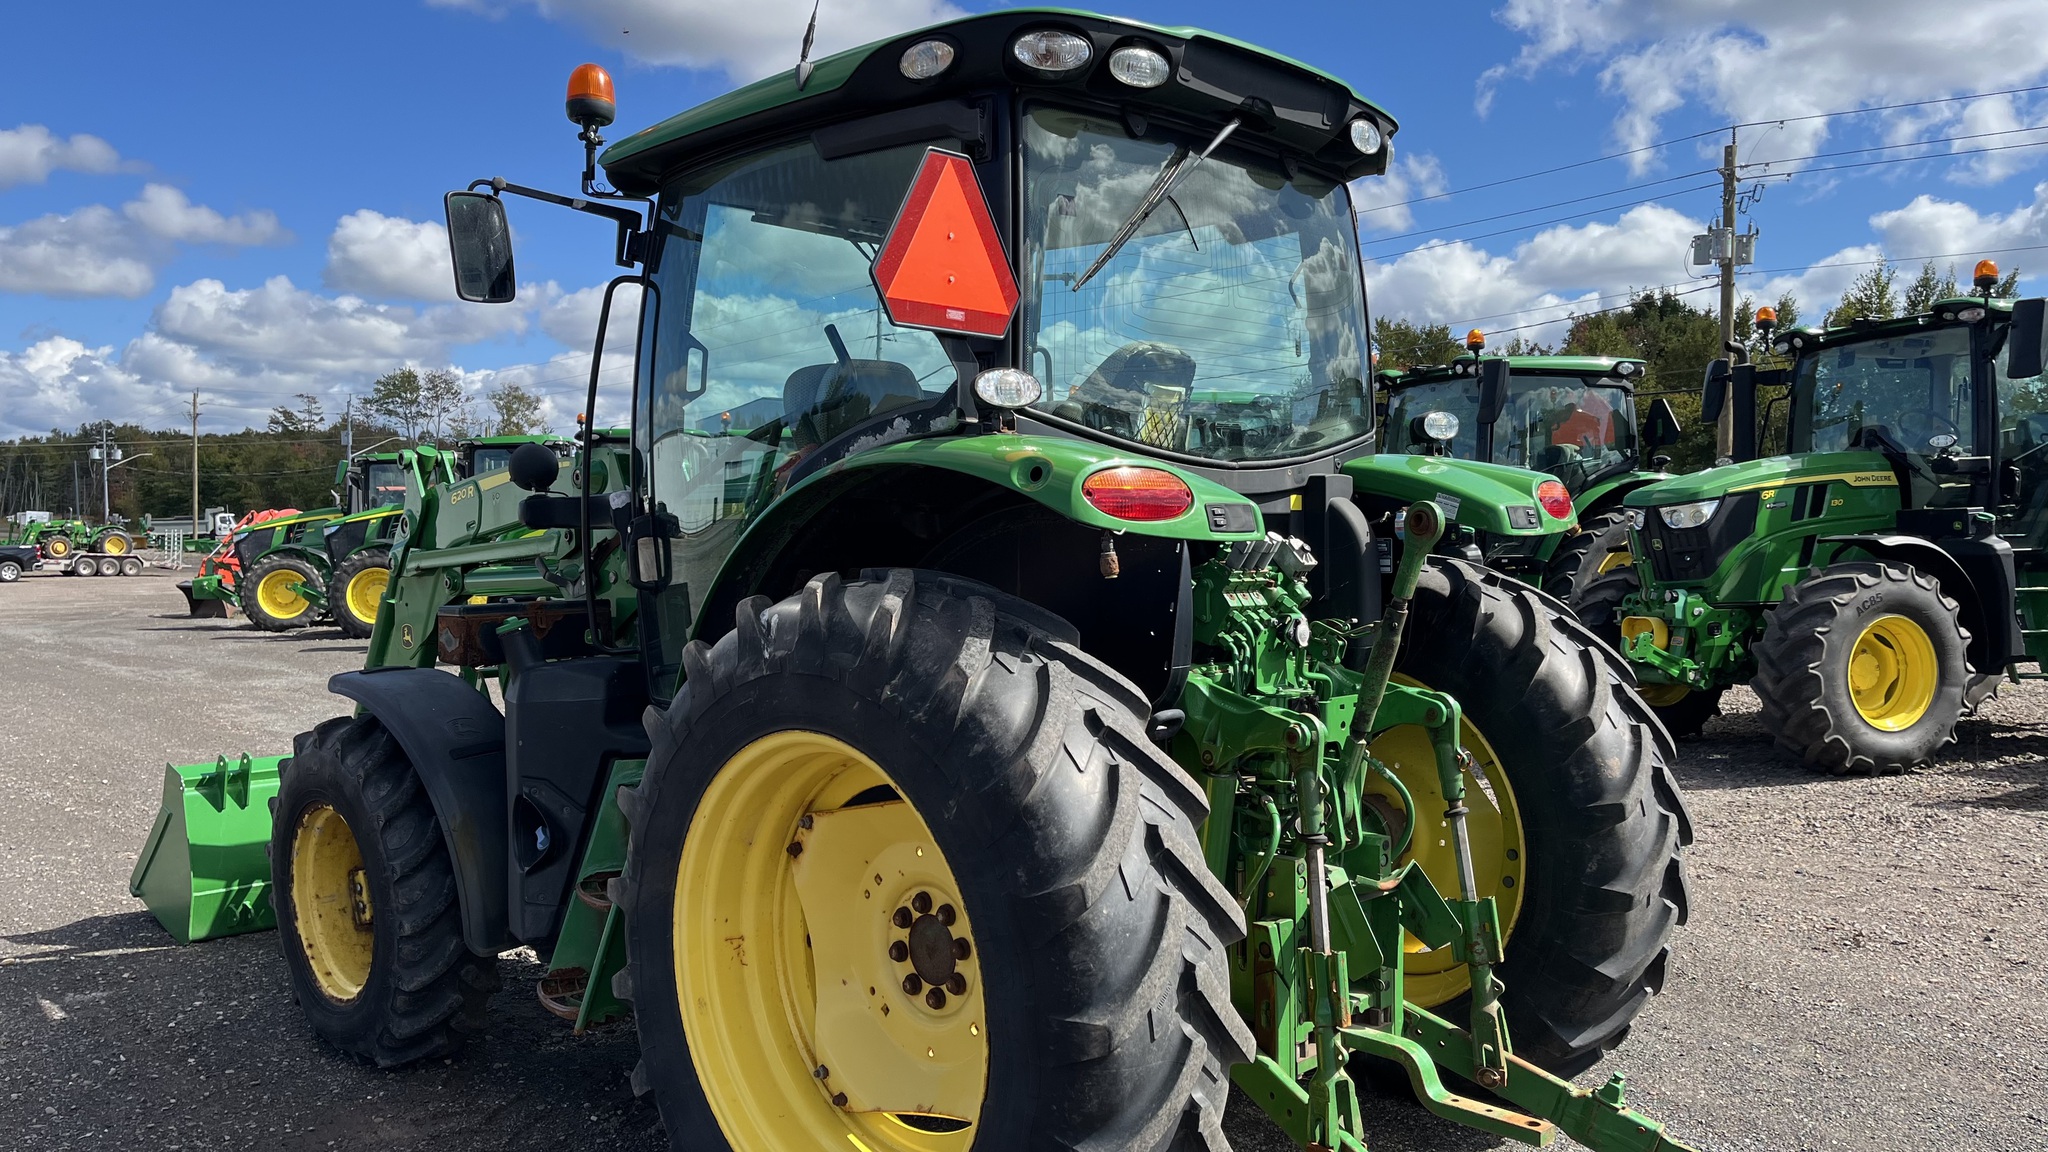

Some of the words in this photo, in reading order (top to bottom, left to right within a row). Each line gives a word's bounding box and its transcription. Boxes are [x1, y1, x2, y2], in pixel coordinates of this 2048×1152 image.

[1854, 475, 1871, 483] JOHN
[1761, 490, 1775, 500] 6R
[1856, 592, 1884, 617] AC85
